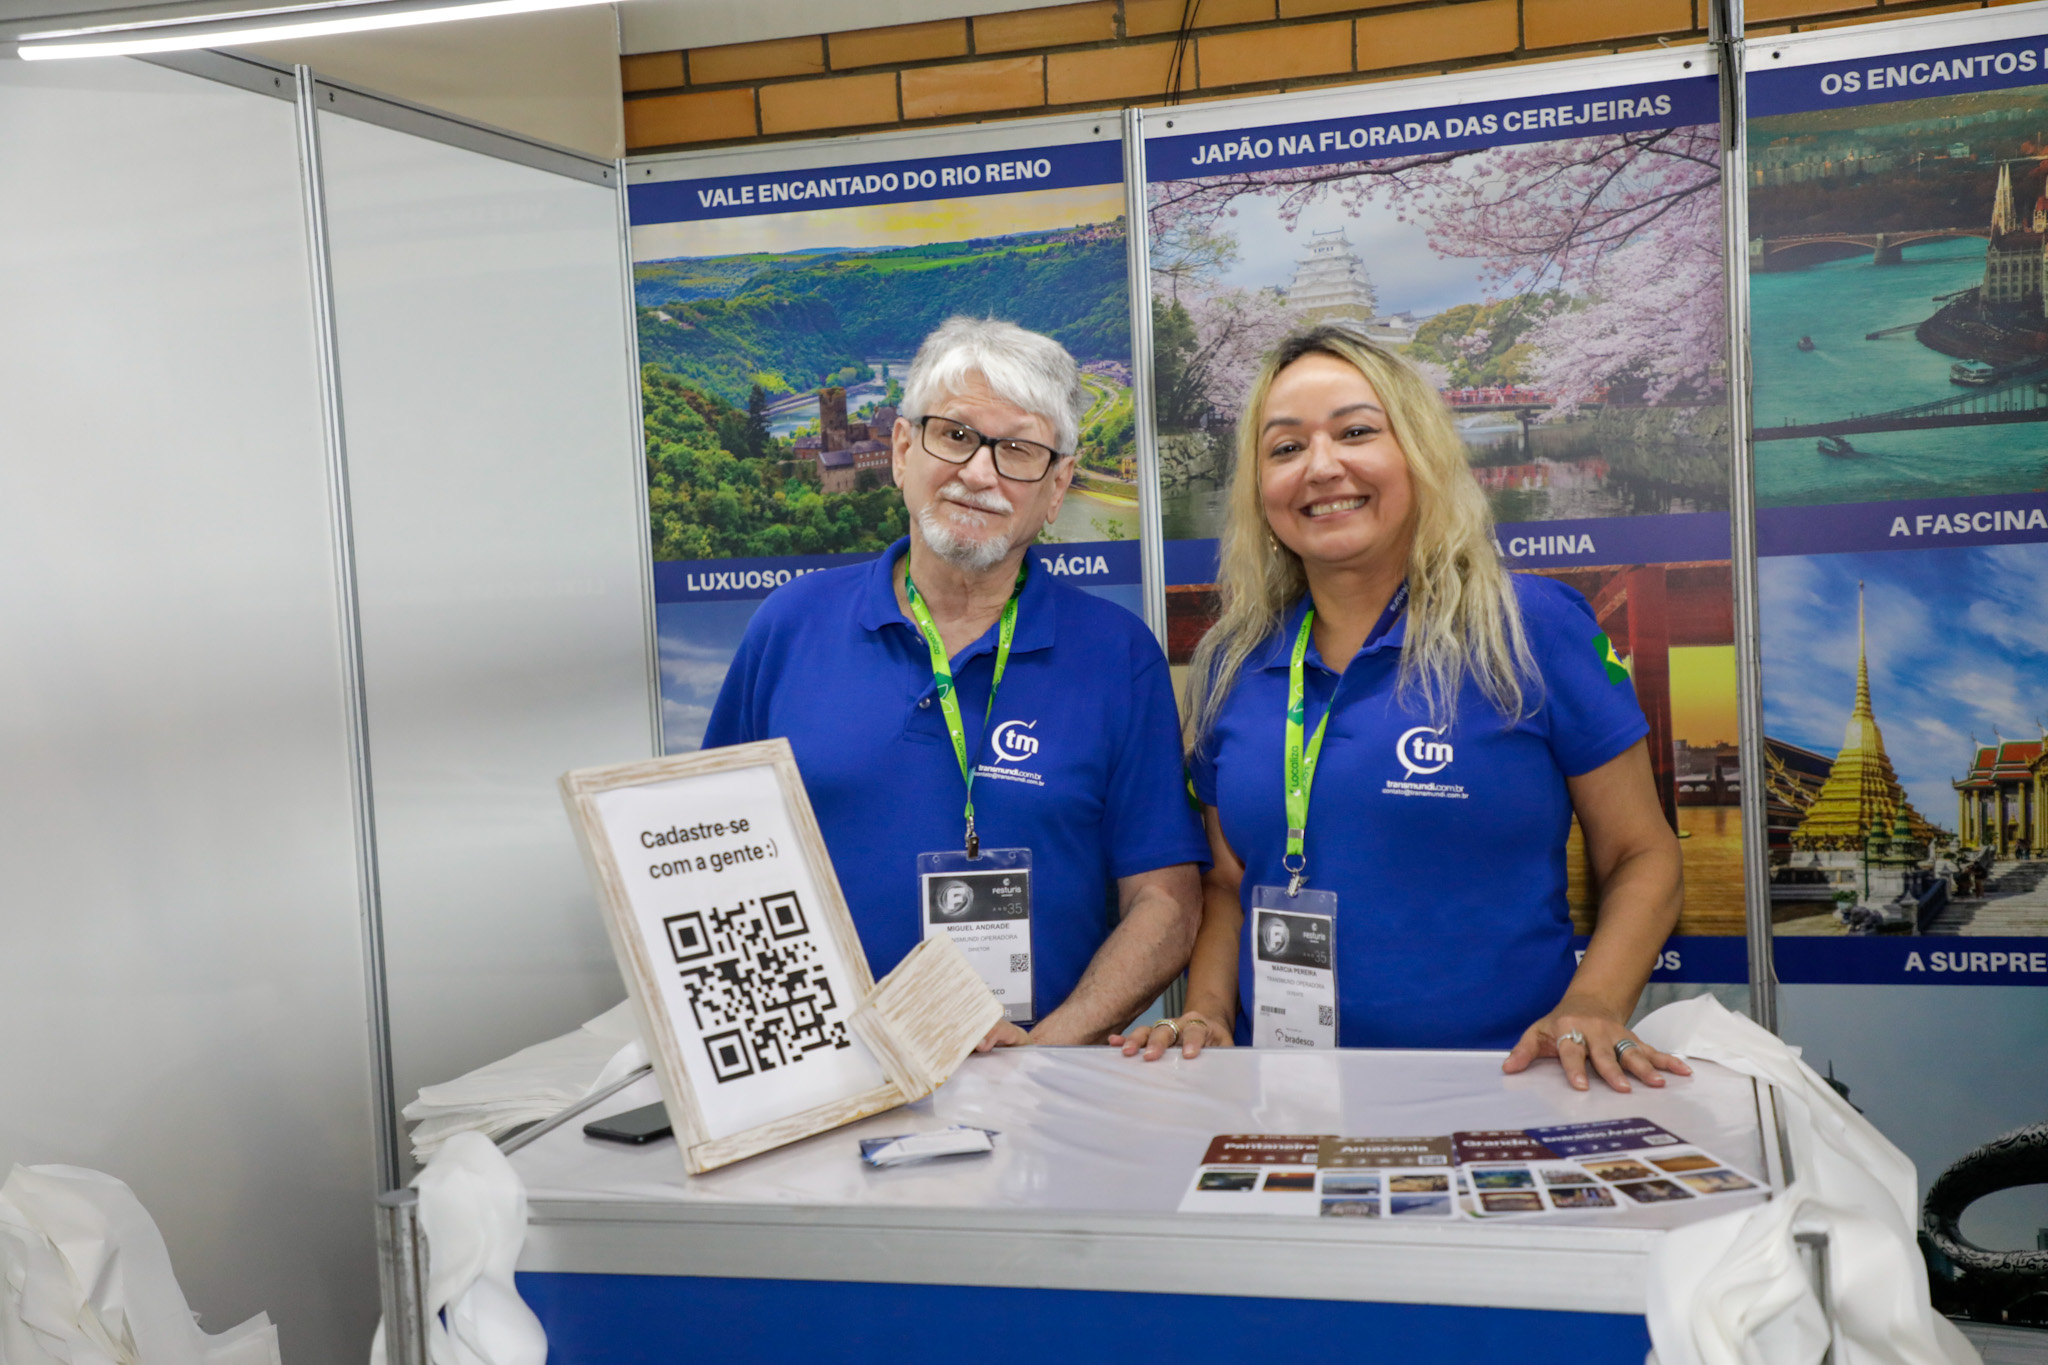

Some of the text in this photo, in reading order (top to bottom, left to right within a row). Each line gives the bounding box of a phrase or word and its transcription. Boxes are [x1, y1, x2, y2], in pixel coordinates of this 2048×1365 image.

[1820, 71, 1861, 95] OS
[1867, 49, 2037, 90] ENCANTOS
[1191, 94, 1672, 166] JAPÃO NA FLORADA DAS CEREJEIRAS
[698, 158, 1052, 208] VALE ENCANTADO DO RIO RENO
[1889, 508, 2048, 537] A FASCINA
[1509, 534, 1596, 557] CHINA
[687, 569, 792, 591] LUXUOSO
[1006, 729, 1039, 754] tm
[1412, 737, 1454, 763] tm
[978, 764, 1042, 780] transmundi.com.br
[1291, 746, 1299, 787] Localiza
[1386, 780, 1465, 793] transmundi.com.br
[640, 818, 750, 849] Cadastre-se
[649, 857, 693, 879] com
[695, 856, 707, 871] a
[710, 845, 764, 873] gente
[1007, 902, 1023, 915] 35
[975, 923, 1010, 931] ANDRADE
[1904, 951, 2048, 973] A SURPRE
[1284, 1034, 1315, 1047] bradesco
